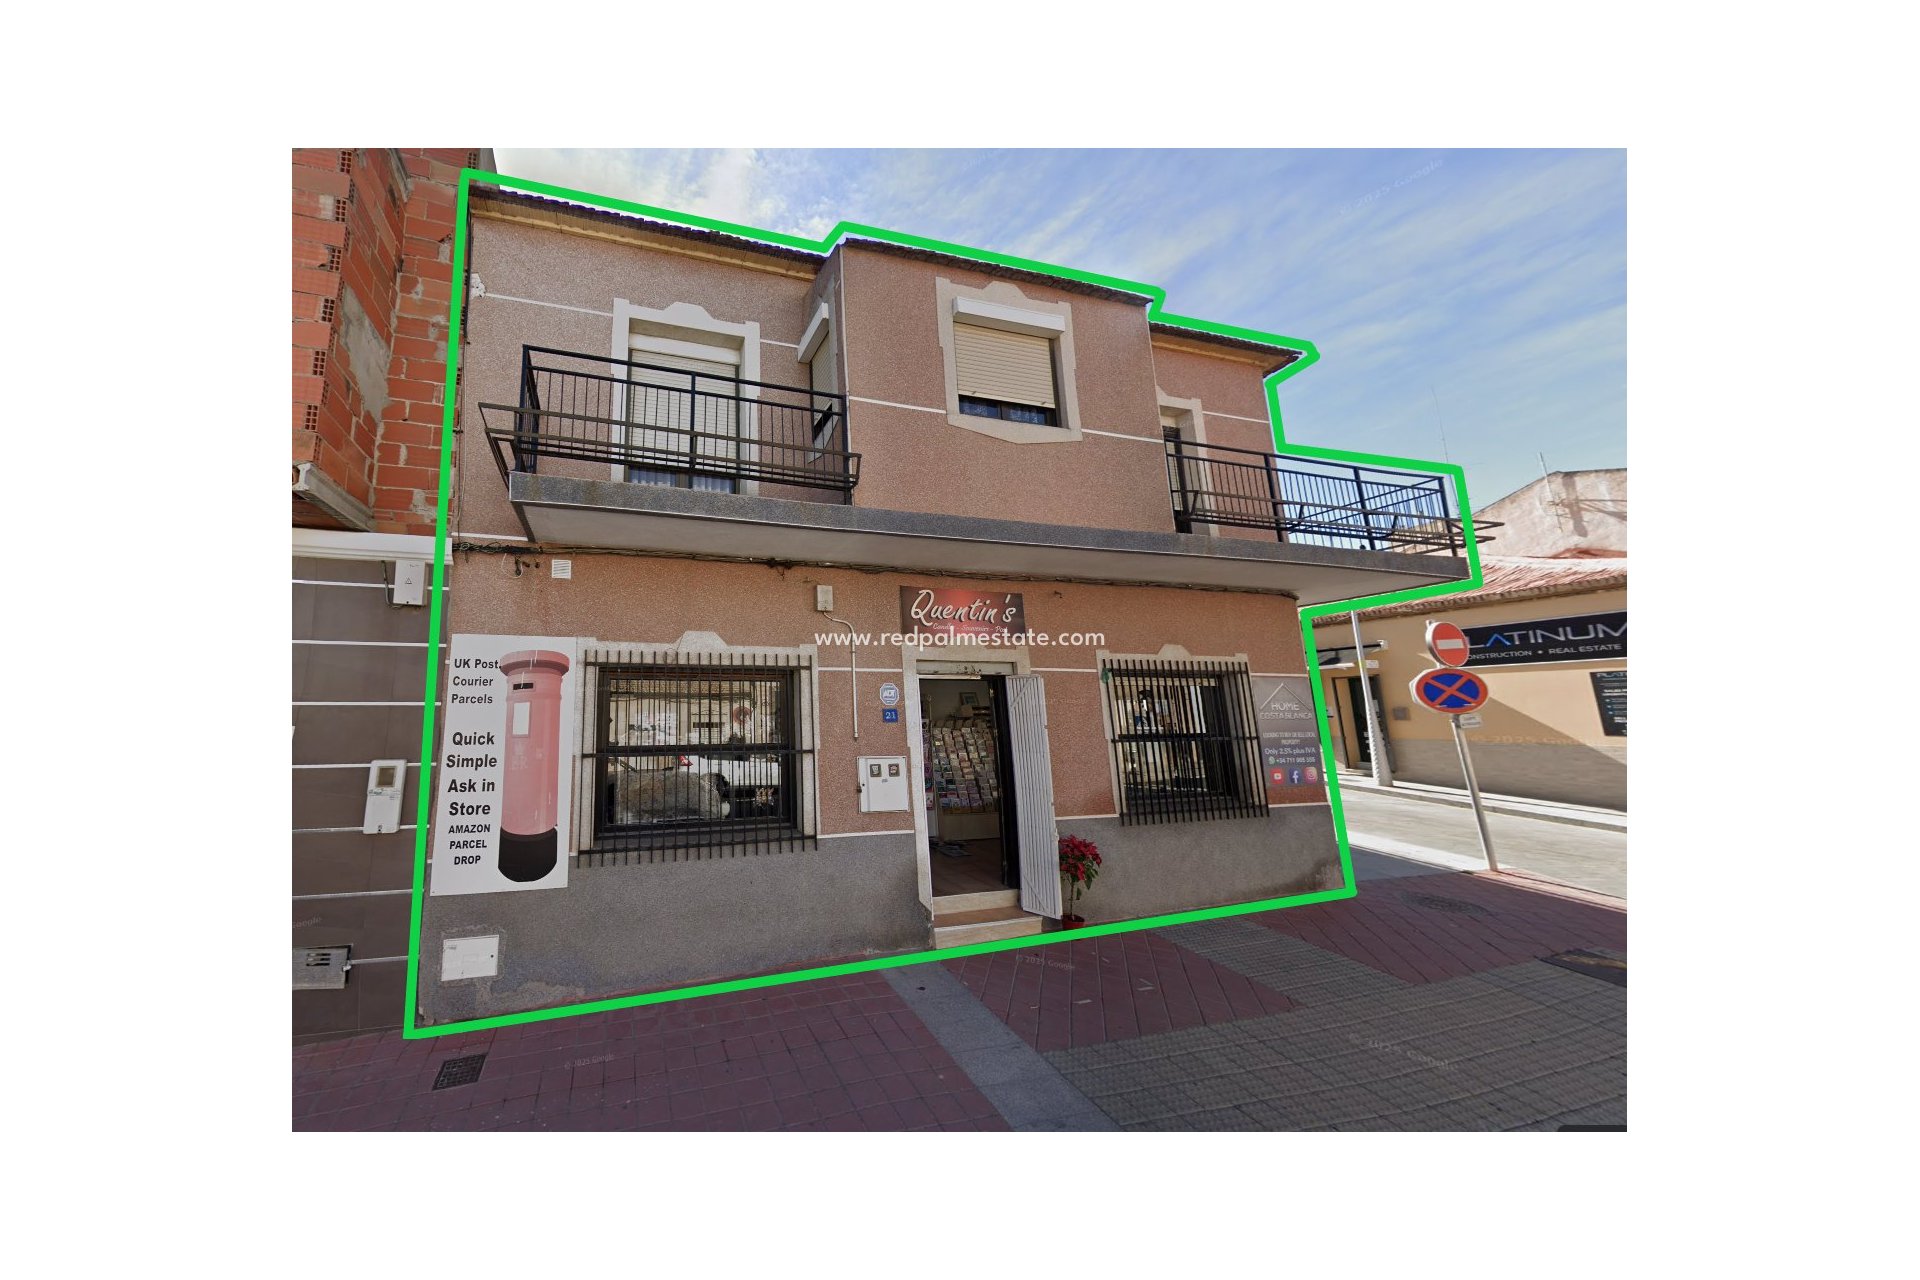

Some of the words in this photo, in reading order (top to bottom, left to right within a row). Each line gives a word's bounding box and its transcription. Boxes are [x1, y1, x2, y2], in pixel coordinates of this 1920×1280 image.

[911, 589, 1016, 626] Quentin's
[1466, 622, 1627, 648] LATINUM
[1468, 650, 1532, 660] ONSTRUCTION
[1578, 643, 1622, 652] ESTATE
[454, 658, 471, 669] UK
[453, 676, 494, 686] Courier
[451, 693, 493, 704] Parcels
[1271, 702, 1300, 711] HOME
[885, 711, 897, 720] 21
[1260, 712, 1284, 720] COSTA
[1285, 711, 1312, 720] BLANCA
[452, 731, 495, 746] Quick
[446, 753, 498, 771] Simple
[447, 779, 477, 792] Ask
[481, 778, 495, 792] in
[449, 801, 491, 816] Store
[448, 824, 491, 834] AMAZON
[449, 839, 488, 849] PARCEL
[454, 855, 481, 865] DROP
